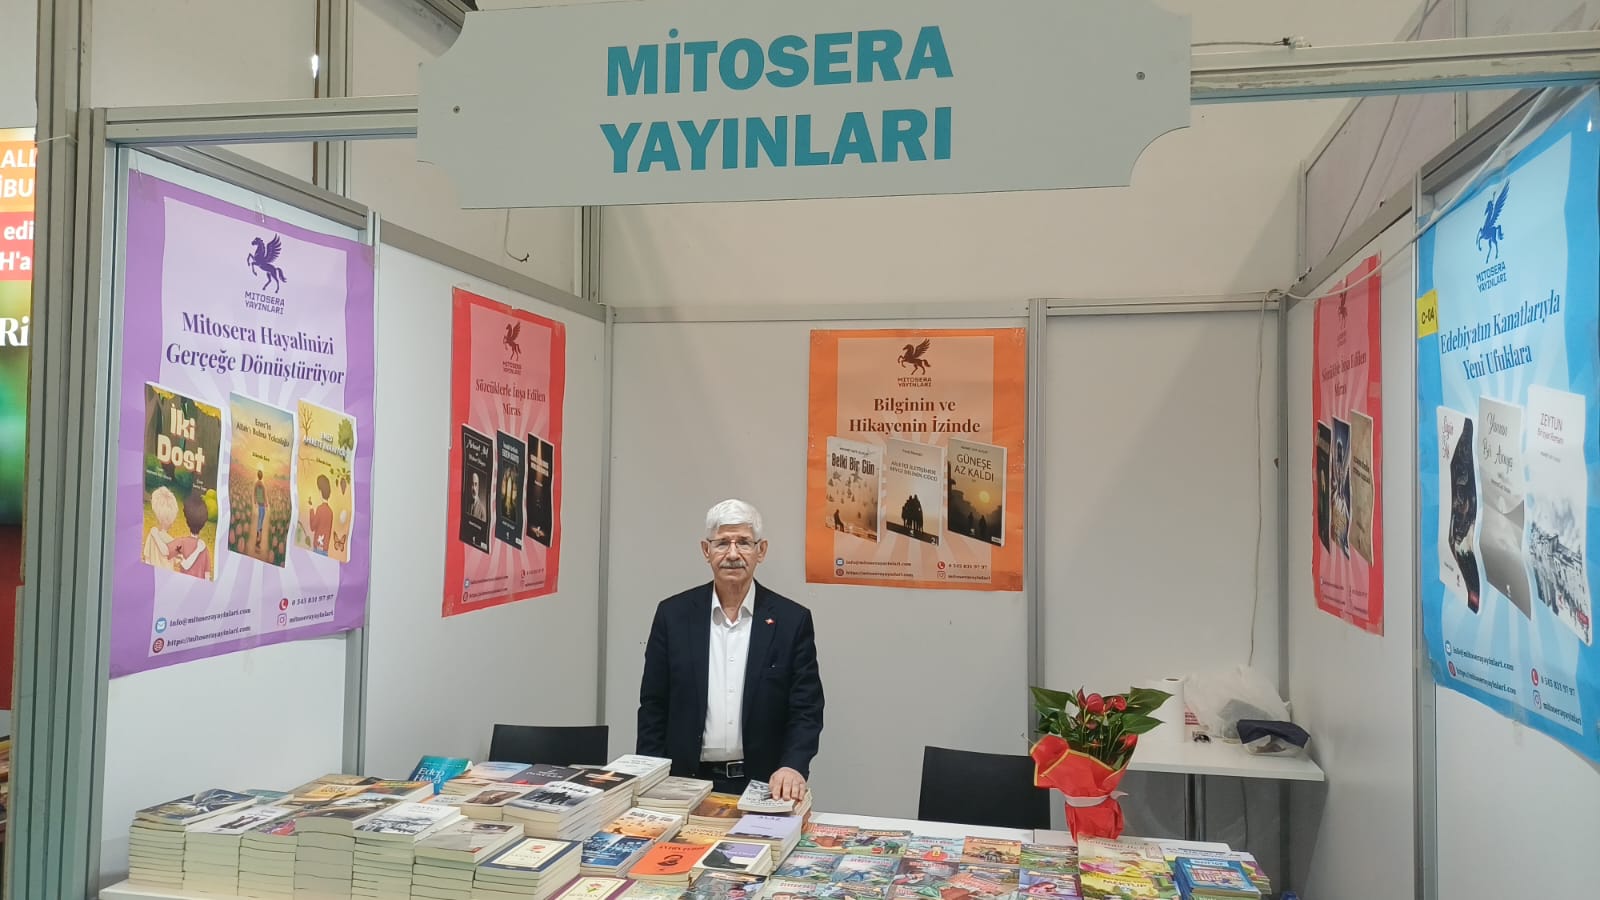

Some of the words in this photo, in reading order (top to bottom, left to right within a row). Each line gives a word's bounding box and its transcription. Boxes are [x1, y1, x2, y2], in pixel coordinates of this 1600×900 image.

[606, 25, 954, 97] MİTOSERA
[600, 106, 953, 174] YAYINLARI
[1476, 261, 1506, 282] MITOSERA
[1478, 273, 1508, 293] YAYINLARI
[244, 290, 285, 306] MITOSERA
[245, 299, 284, 315] YAYINLARI
[1421, 307, 1435, 325] C-04
[1440, 321, 1491, 355] Edebiyatın
[1493, 289, 1561, 337] Kanatlarıyla
[182, 312, 257, 344] Mitosera
[260, 327, 335, 355] Hayalinizi
[166, 343, 237, 374] Gerçeğe
[240, 352, 345, 387] Dönüştürüyor
[1462, 354, 1486, 380] Yeni
[1487, 344, 1533, 376] Ufuklara
[475, 378, 511, 397] Sözcüklerle
[527, 387, 546, 402] Edilen
[502, 402, 521, 417] Miras
[874, 397, 935, 414] Bilginin
[940, 400, 956, 412] ve
[170, 404, 196, 440] İki
[849, 418, 928, 435] Hikayenin
[932, 415, 981, 433] İzinde
[1540, 412, 1563, 432] ZEYTUN
[157, 433, 205, 474] Dost
[831, 452, 848, 470] Belki
[849, 456, 860, 472] Bir
[862, 459, 875, 476] Gün
[956, 453, 992, 470] GÜNEŞE
[954, 465, 966, 475] AZ
[968, 467, 994, 482] KALDI
